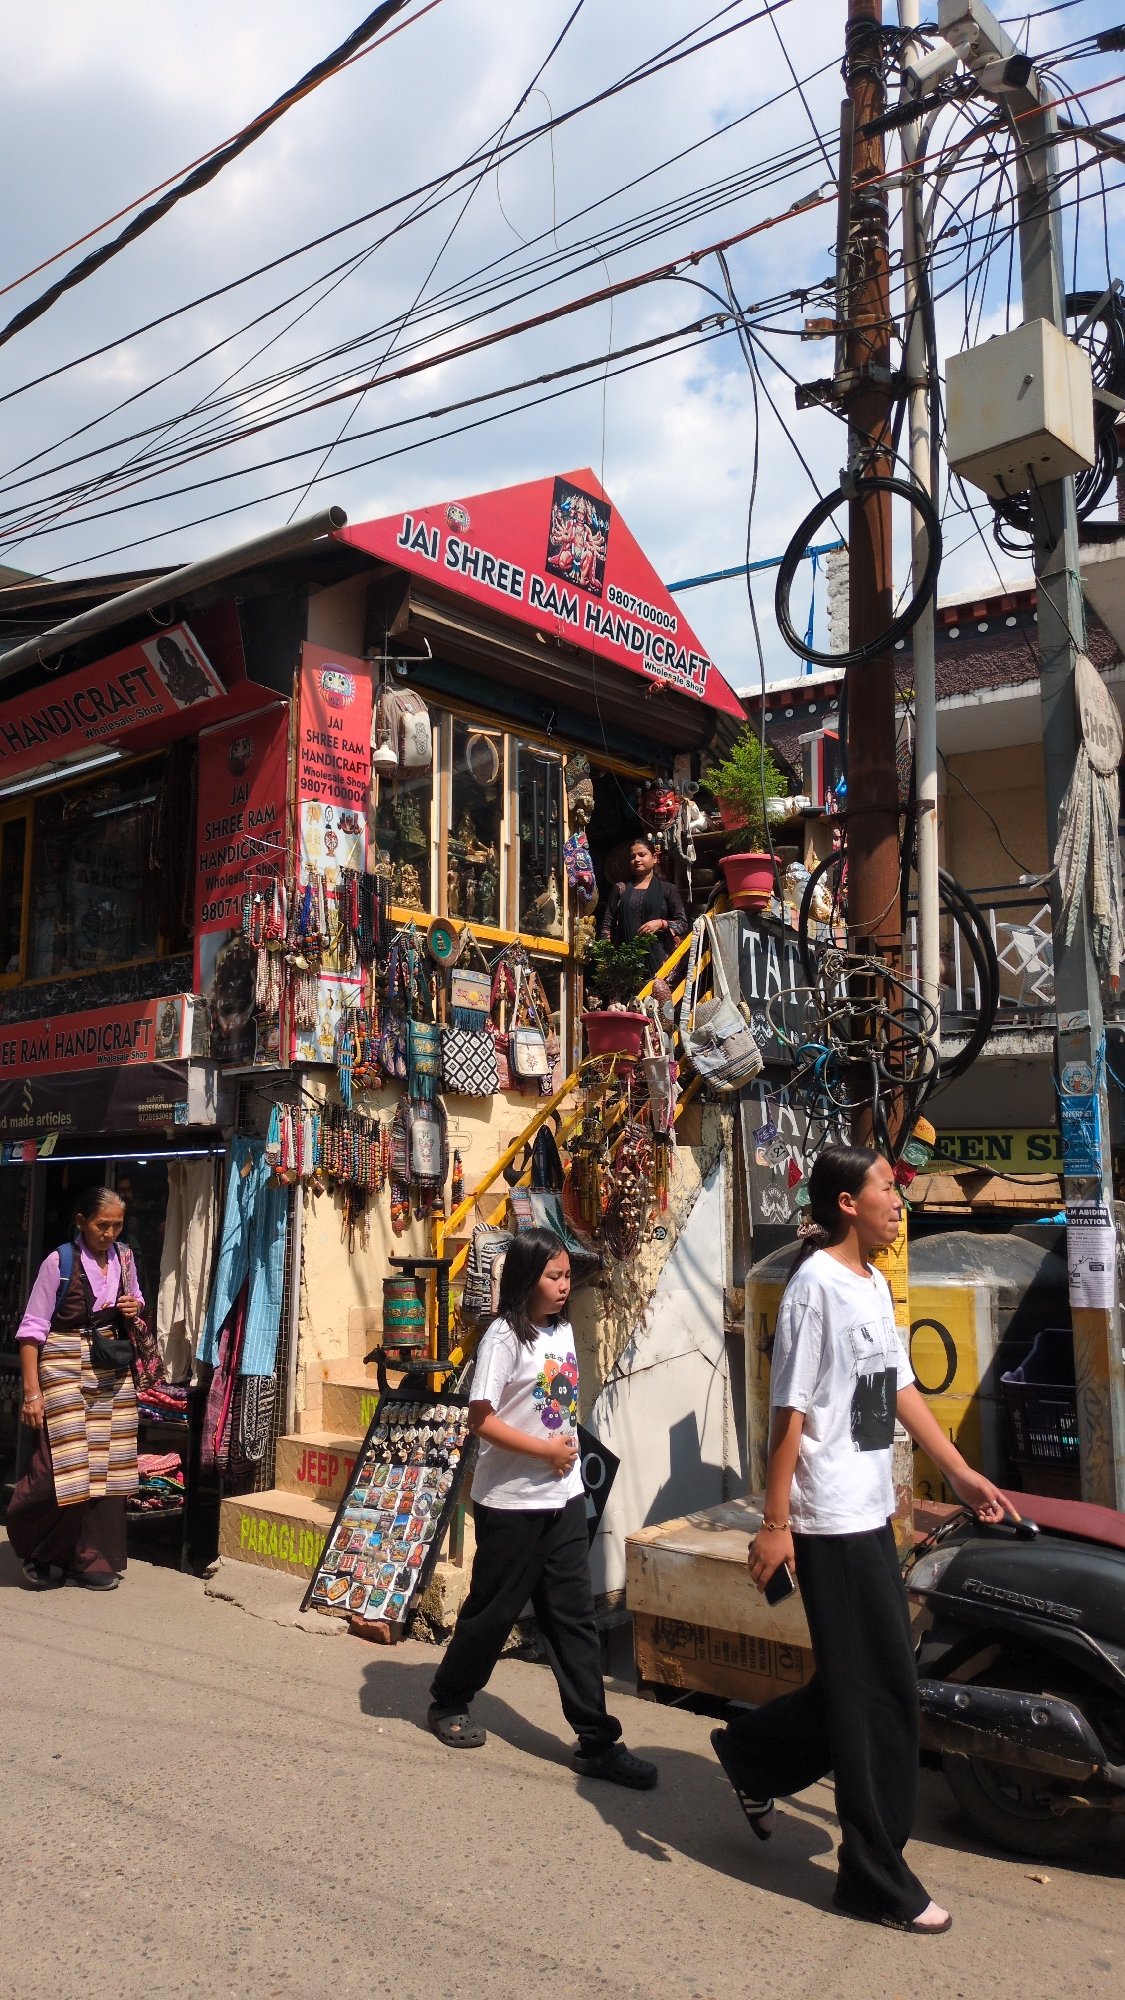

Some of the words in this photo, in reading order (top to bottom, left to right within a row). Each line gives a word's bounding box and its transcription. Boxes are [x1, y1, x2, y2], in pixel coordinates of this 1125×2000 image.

[399, 515, 439, 560] JAI
[446, 538, 524, 598] SHREE
[530, 573, 579, 625] RAM
[585, 602, 711, 685] HANDICRAFT
[608, 586, 678, 632] 9807100004
[644, 660, 684, 684] Wholesale
[684, 675, 705, 695] Shop
[1, 667, 157, 755] HANDICRAFT
[83, 712, 136, 740] Wholesale
[136, 702, 165, 724] Shop
[327, 715, 343, 731] JAI
[306, 729, 339, 752] SHREE
[341, 739, 366, 756] RAM
[1084, 708, 1115, 754] SHOP
[301, 747, 369, 776] HANDICRAFT
[230, 782, 250, 807] JAI
[300, 777, 368, 804] 9807100004
[303, 765, 345, 786] Wholesale
[346, 775, 367, 792] Shop
[205, 810, 244, 842] SHREE
[248, 804, 276, 829] RAM
[200, 831, 282, 871] HANDICRAFT
[255, 861, 280, 880] Shop
[20, 1033, 50, 1064] RAM
[55, 1019, 153, 1059] HANDICRAFT
[97, 1053, 129, 1064] Wholesale
[130, 1051, 148, 1061] Shop
[10, 1113, 33, 1128] made
[36, 1111, 72, 1126] articles
[1062, 1110, 1092, 1118] NTERNET
[297, 1449, 339, 1488] JEEP
